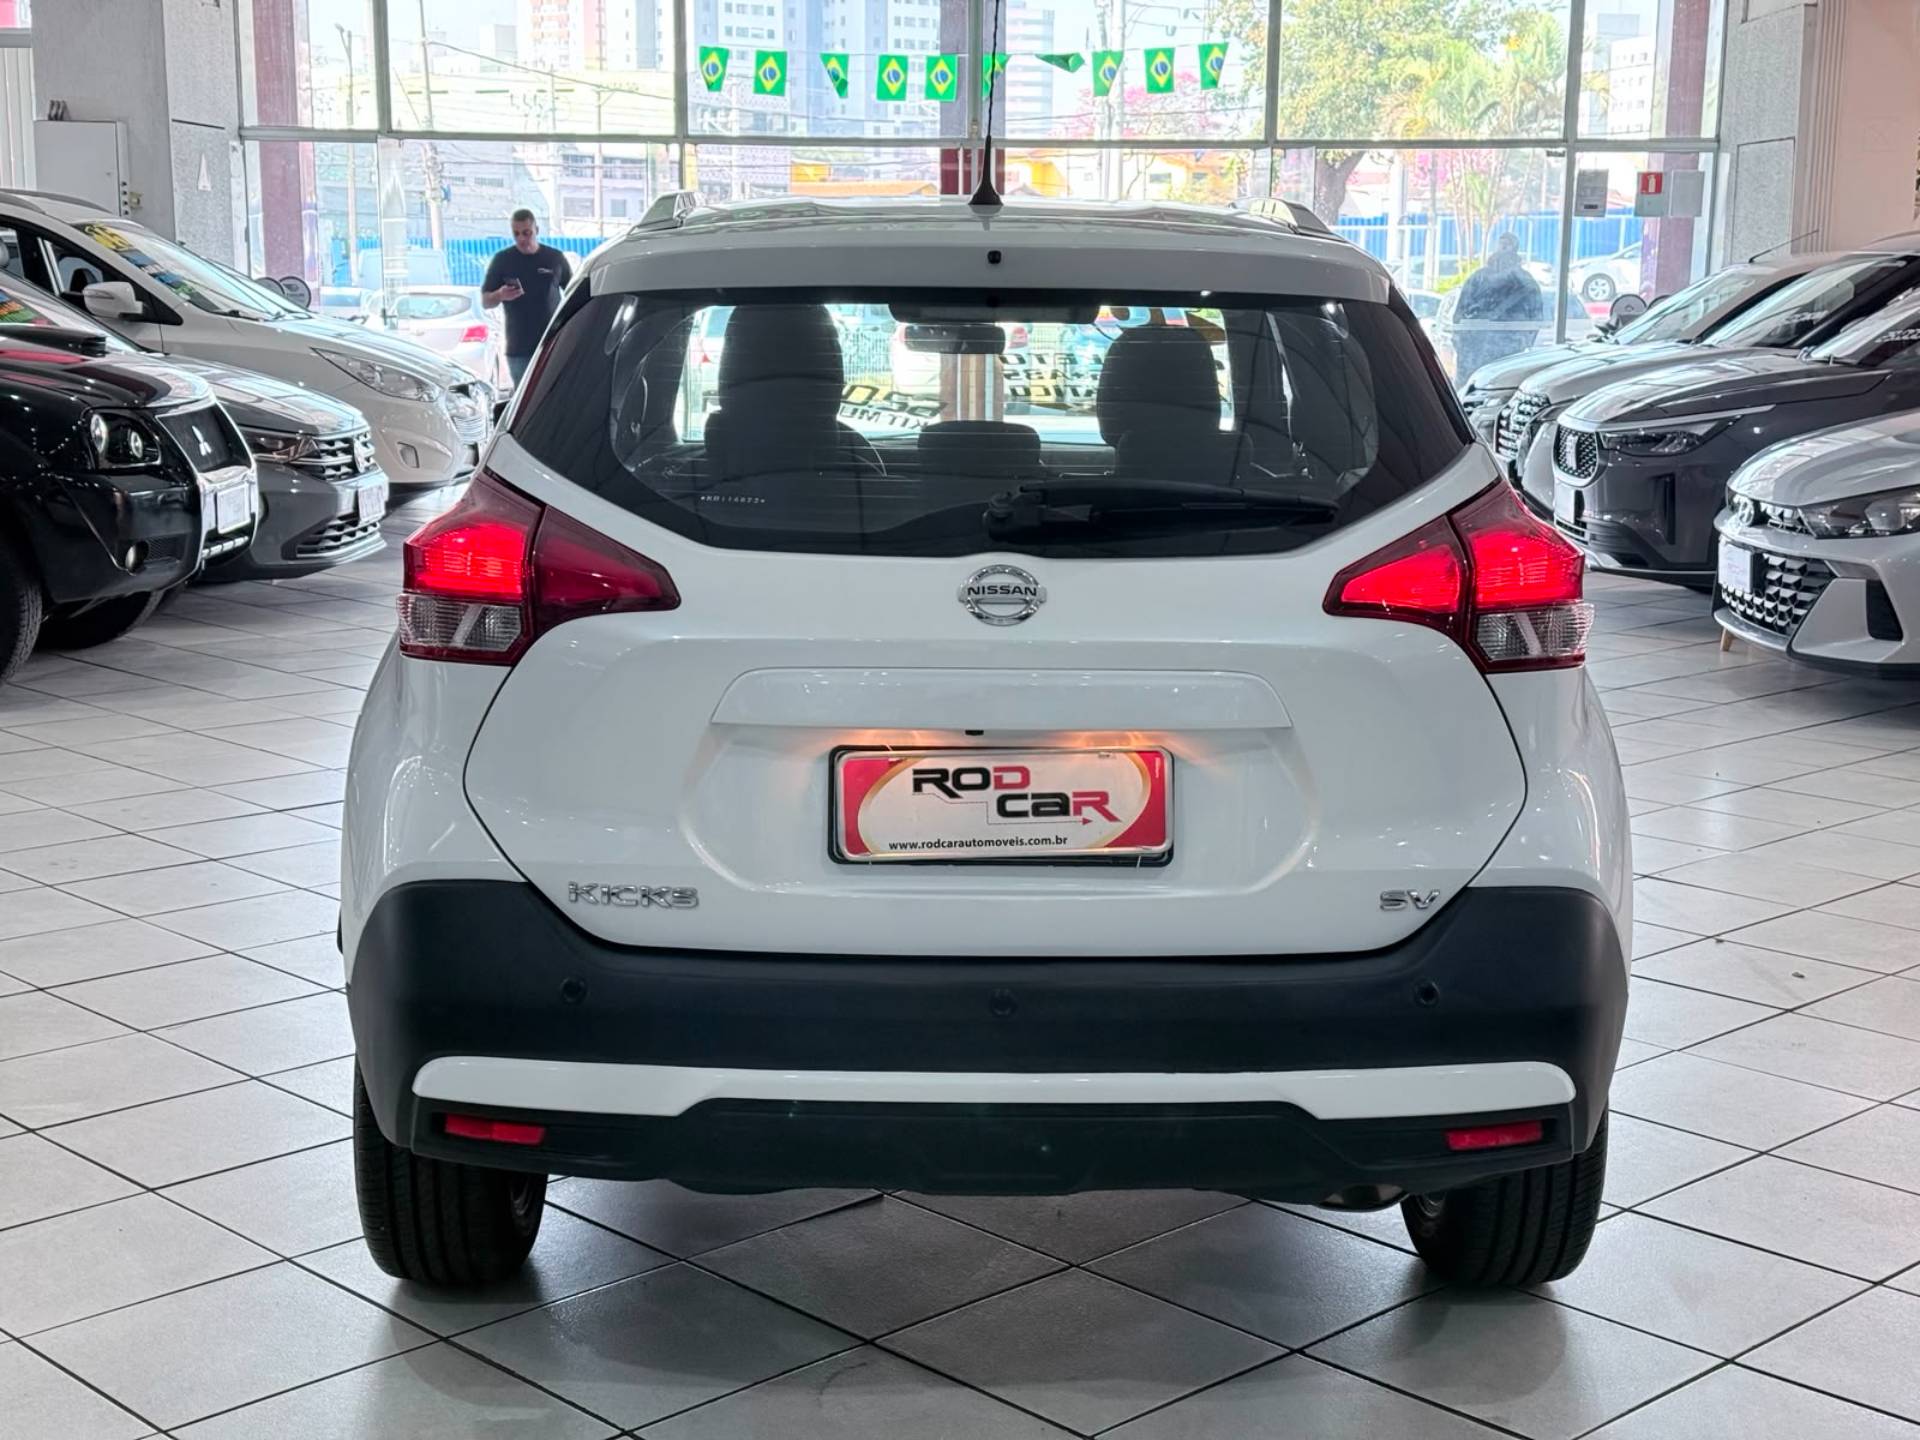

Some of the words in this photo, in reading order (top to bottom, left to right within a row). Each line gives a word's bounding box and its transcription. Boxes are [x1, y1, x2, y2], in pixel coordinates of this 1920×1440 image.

[967, 584, 1038, 598] NISSAN
[912, 766, 1031, 798] ROD
[889, 835, 1068, 850] www.rodcarautomoveis.com.br
[568, 881, 699, 909] KICKS
[1380, 889, 1440, 911] SV
